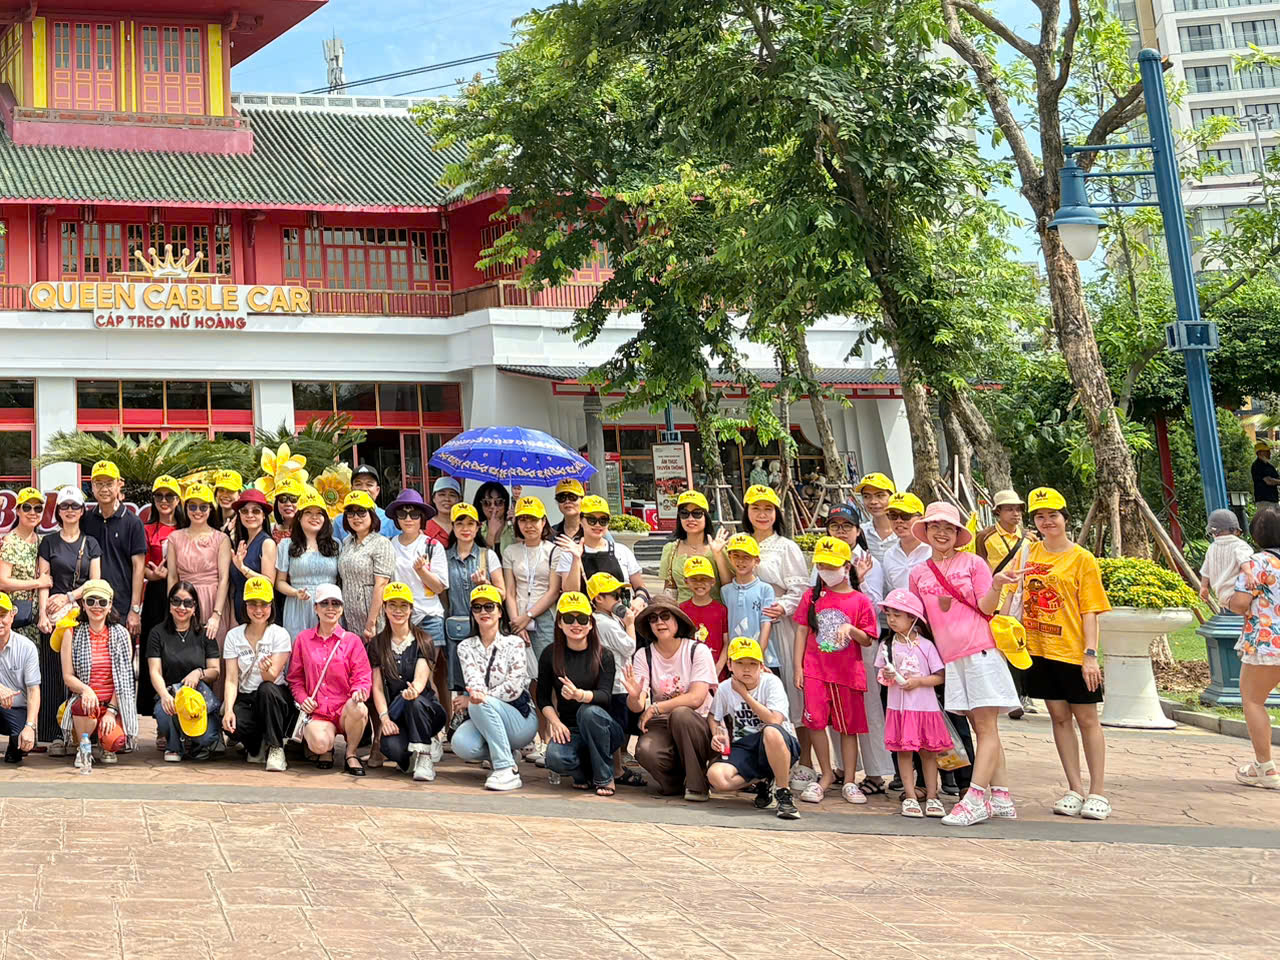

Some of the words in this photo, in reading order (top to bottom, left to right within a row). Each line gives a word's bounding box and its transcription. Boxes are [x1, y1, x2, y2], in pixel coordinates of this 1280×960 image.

[31, 282, 136, 311] QUEEN
[143, 284, 239, 311] CABLE
[247, 286, 310, 313] CAR
[95, 312, 124, 328] CÁP
[127, 315, 166, 328] TREO
[170, 312, 191, 329] NỮ
[195, 313, 247, 329] HOÀNG
